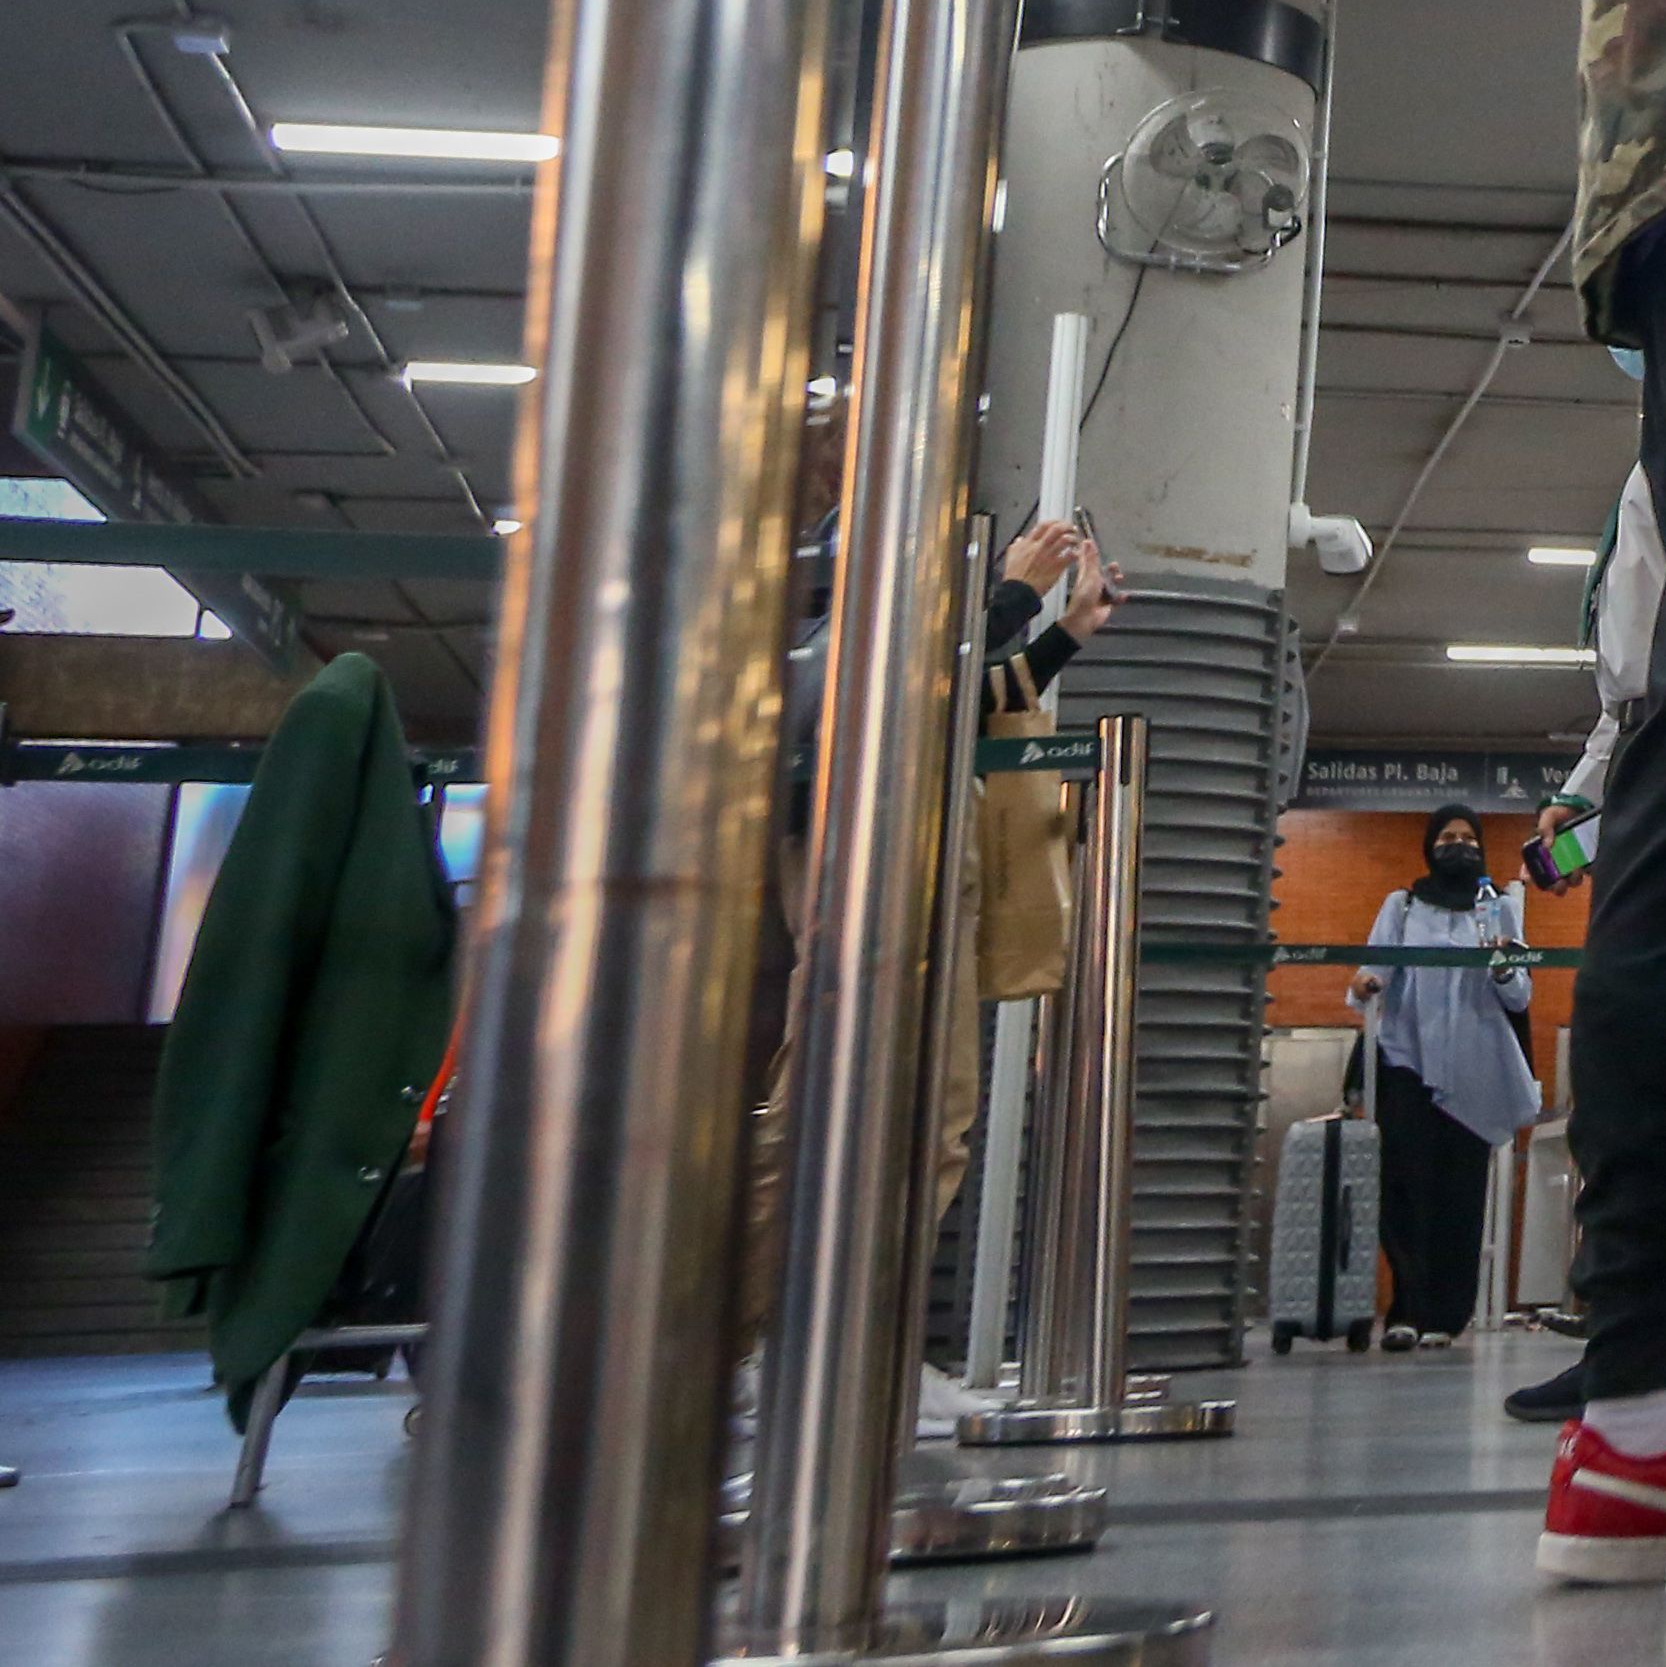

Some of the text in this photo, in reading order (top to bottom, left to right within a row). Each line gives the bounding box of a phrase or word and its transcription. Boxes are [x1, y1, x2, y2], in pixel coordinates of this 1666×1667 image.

[1047, 742, 1095, 758] adif
[1307, 760, 1459, 784] Salidas Pl. Baja
[1508, 950, 1544, 963] adif
